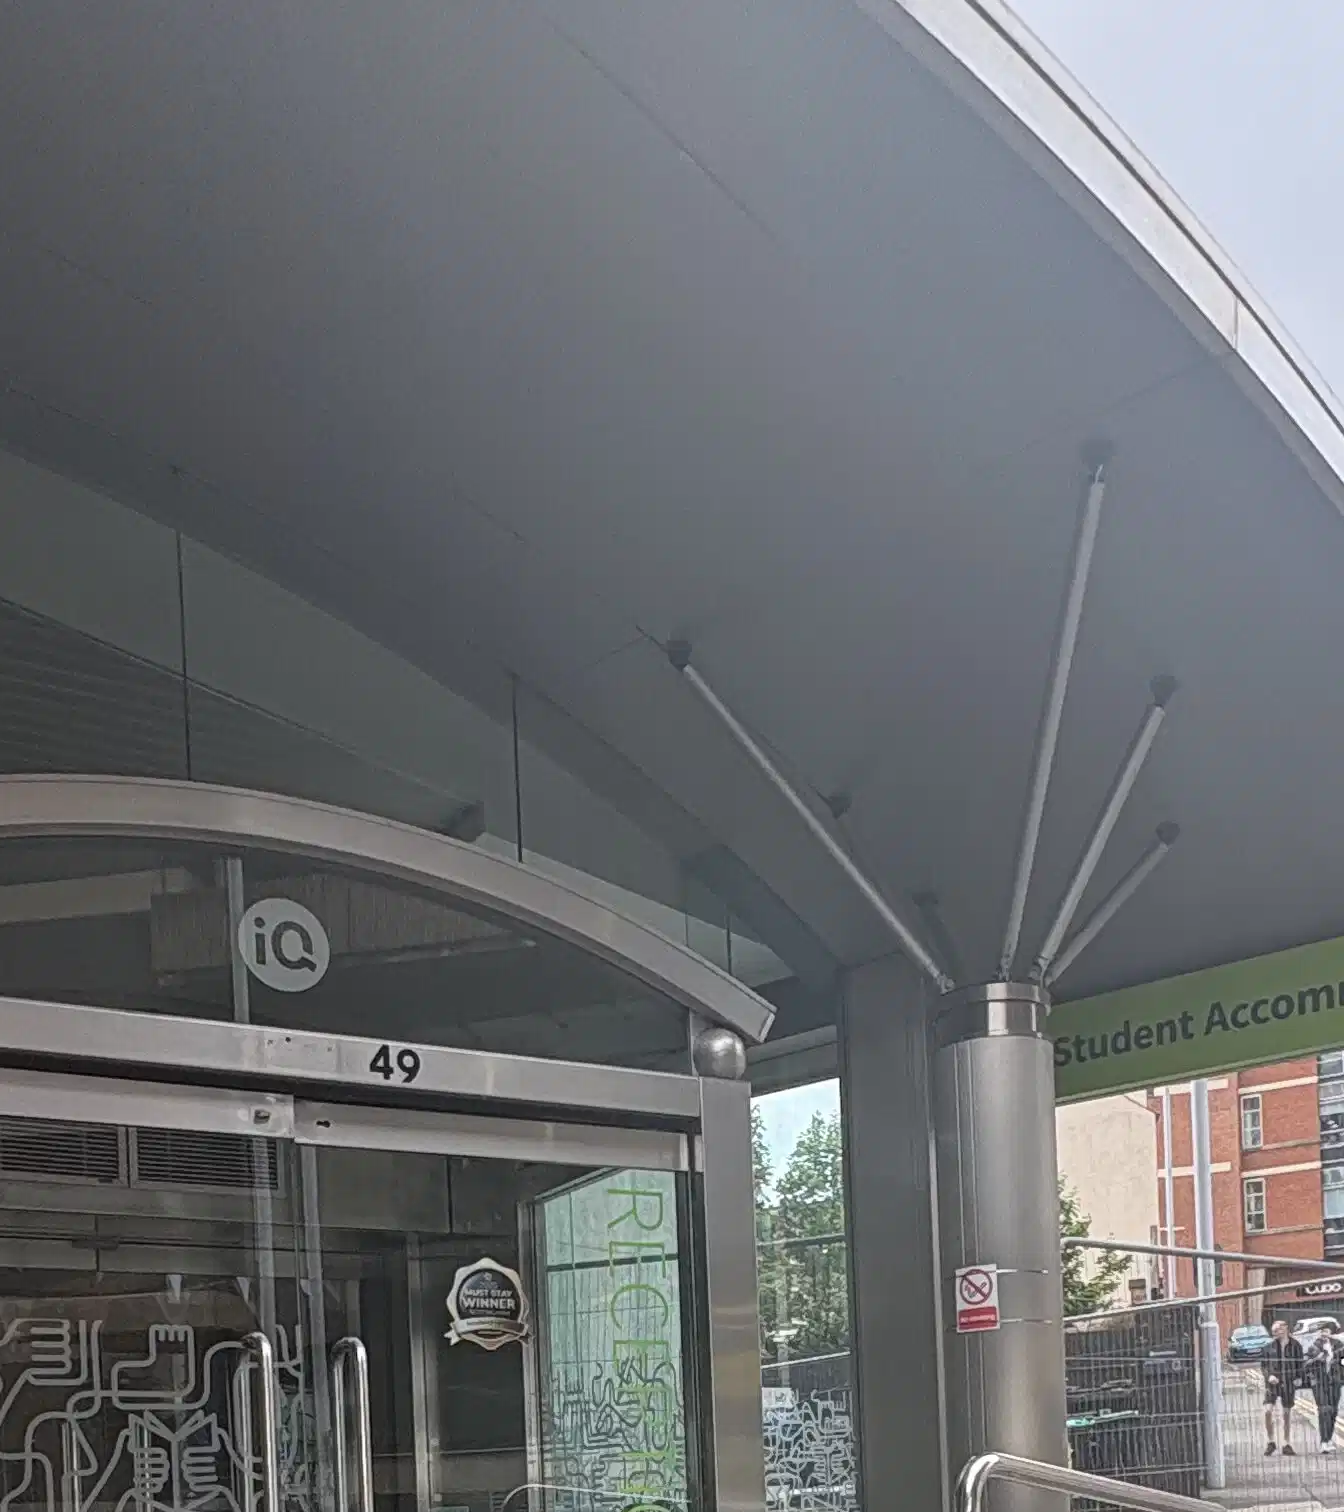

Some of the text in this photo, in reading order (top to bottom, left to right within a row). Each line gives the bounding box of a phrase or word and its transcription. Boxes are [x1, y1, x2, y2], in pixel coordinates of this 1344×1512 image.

[254, 917, 317, 972] iQ
[1053, 1009, 1195, 1068] Student
[369, 1043, 421, 1083] 49
[463, 1297, 516, 1310] WINNER
[491, 1289, 513, 1298] STAY
